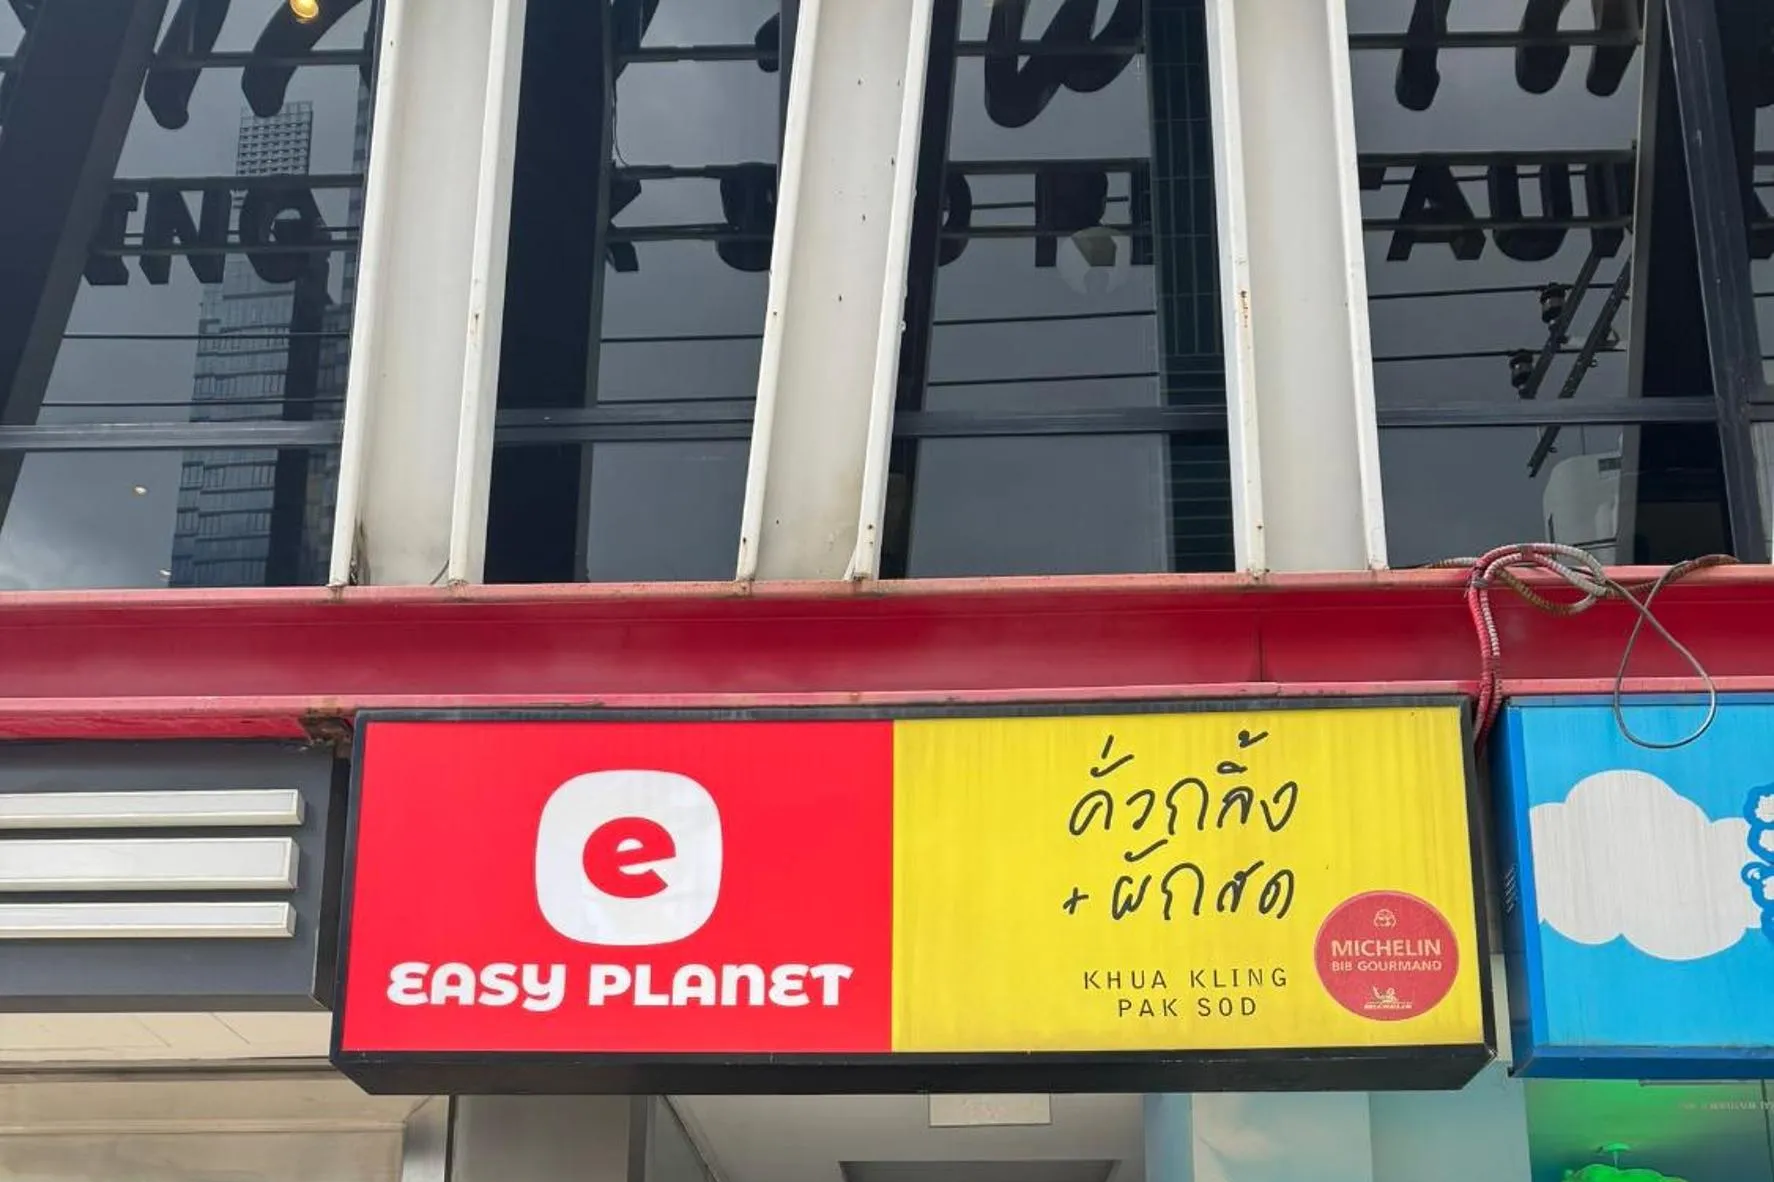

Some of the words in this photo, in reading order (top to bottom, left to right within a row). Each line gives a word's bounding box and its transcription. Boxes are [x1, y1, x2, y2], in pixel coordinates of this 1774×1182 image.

[1069, 730, 1299, 836] คั่วกลิ้ง
[1111, 839, 1295, 921] ผักสด
[1331, 939, 1442, 957] MICHELIN
[1331, 960, 1353, 972] BIB
[1357, 960, 1442, 972] GOURMAND
[386, 961, 567, 1012] EASY
[588, 963, 854, 1007] PLANET
[1084, 970, 1167, 989] KHUA
[1190, 968, 1288, 988] KLING
[1118, 998, 1178, 1017] PAK
[1198, 997, 1257, 1017] SOD
